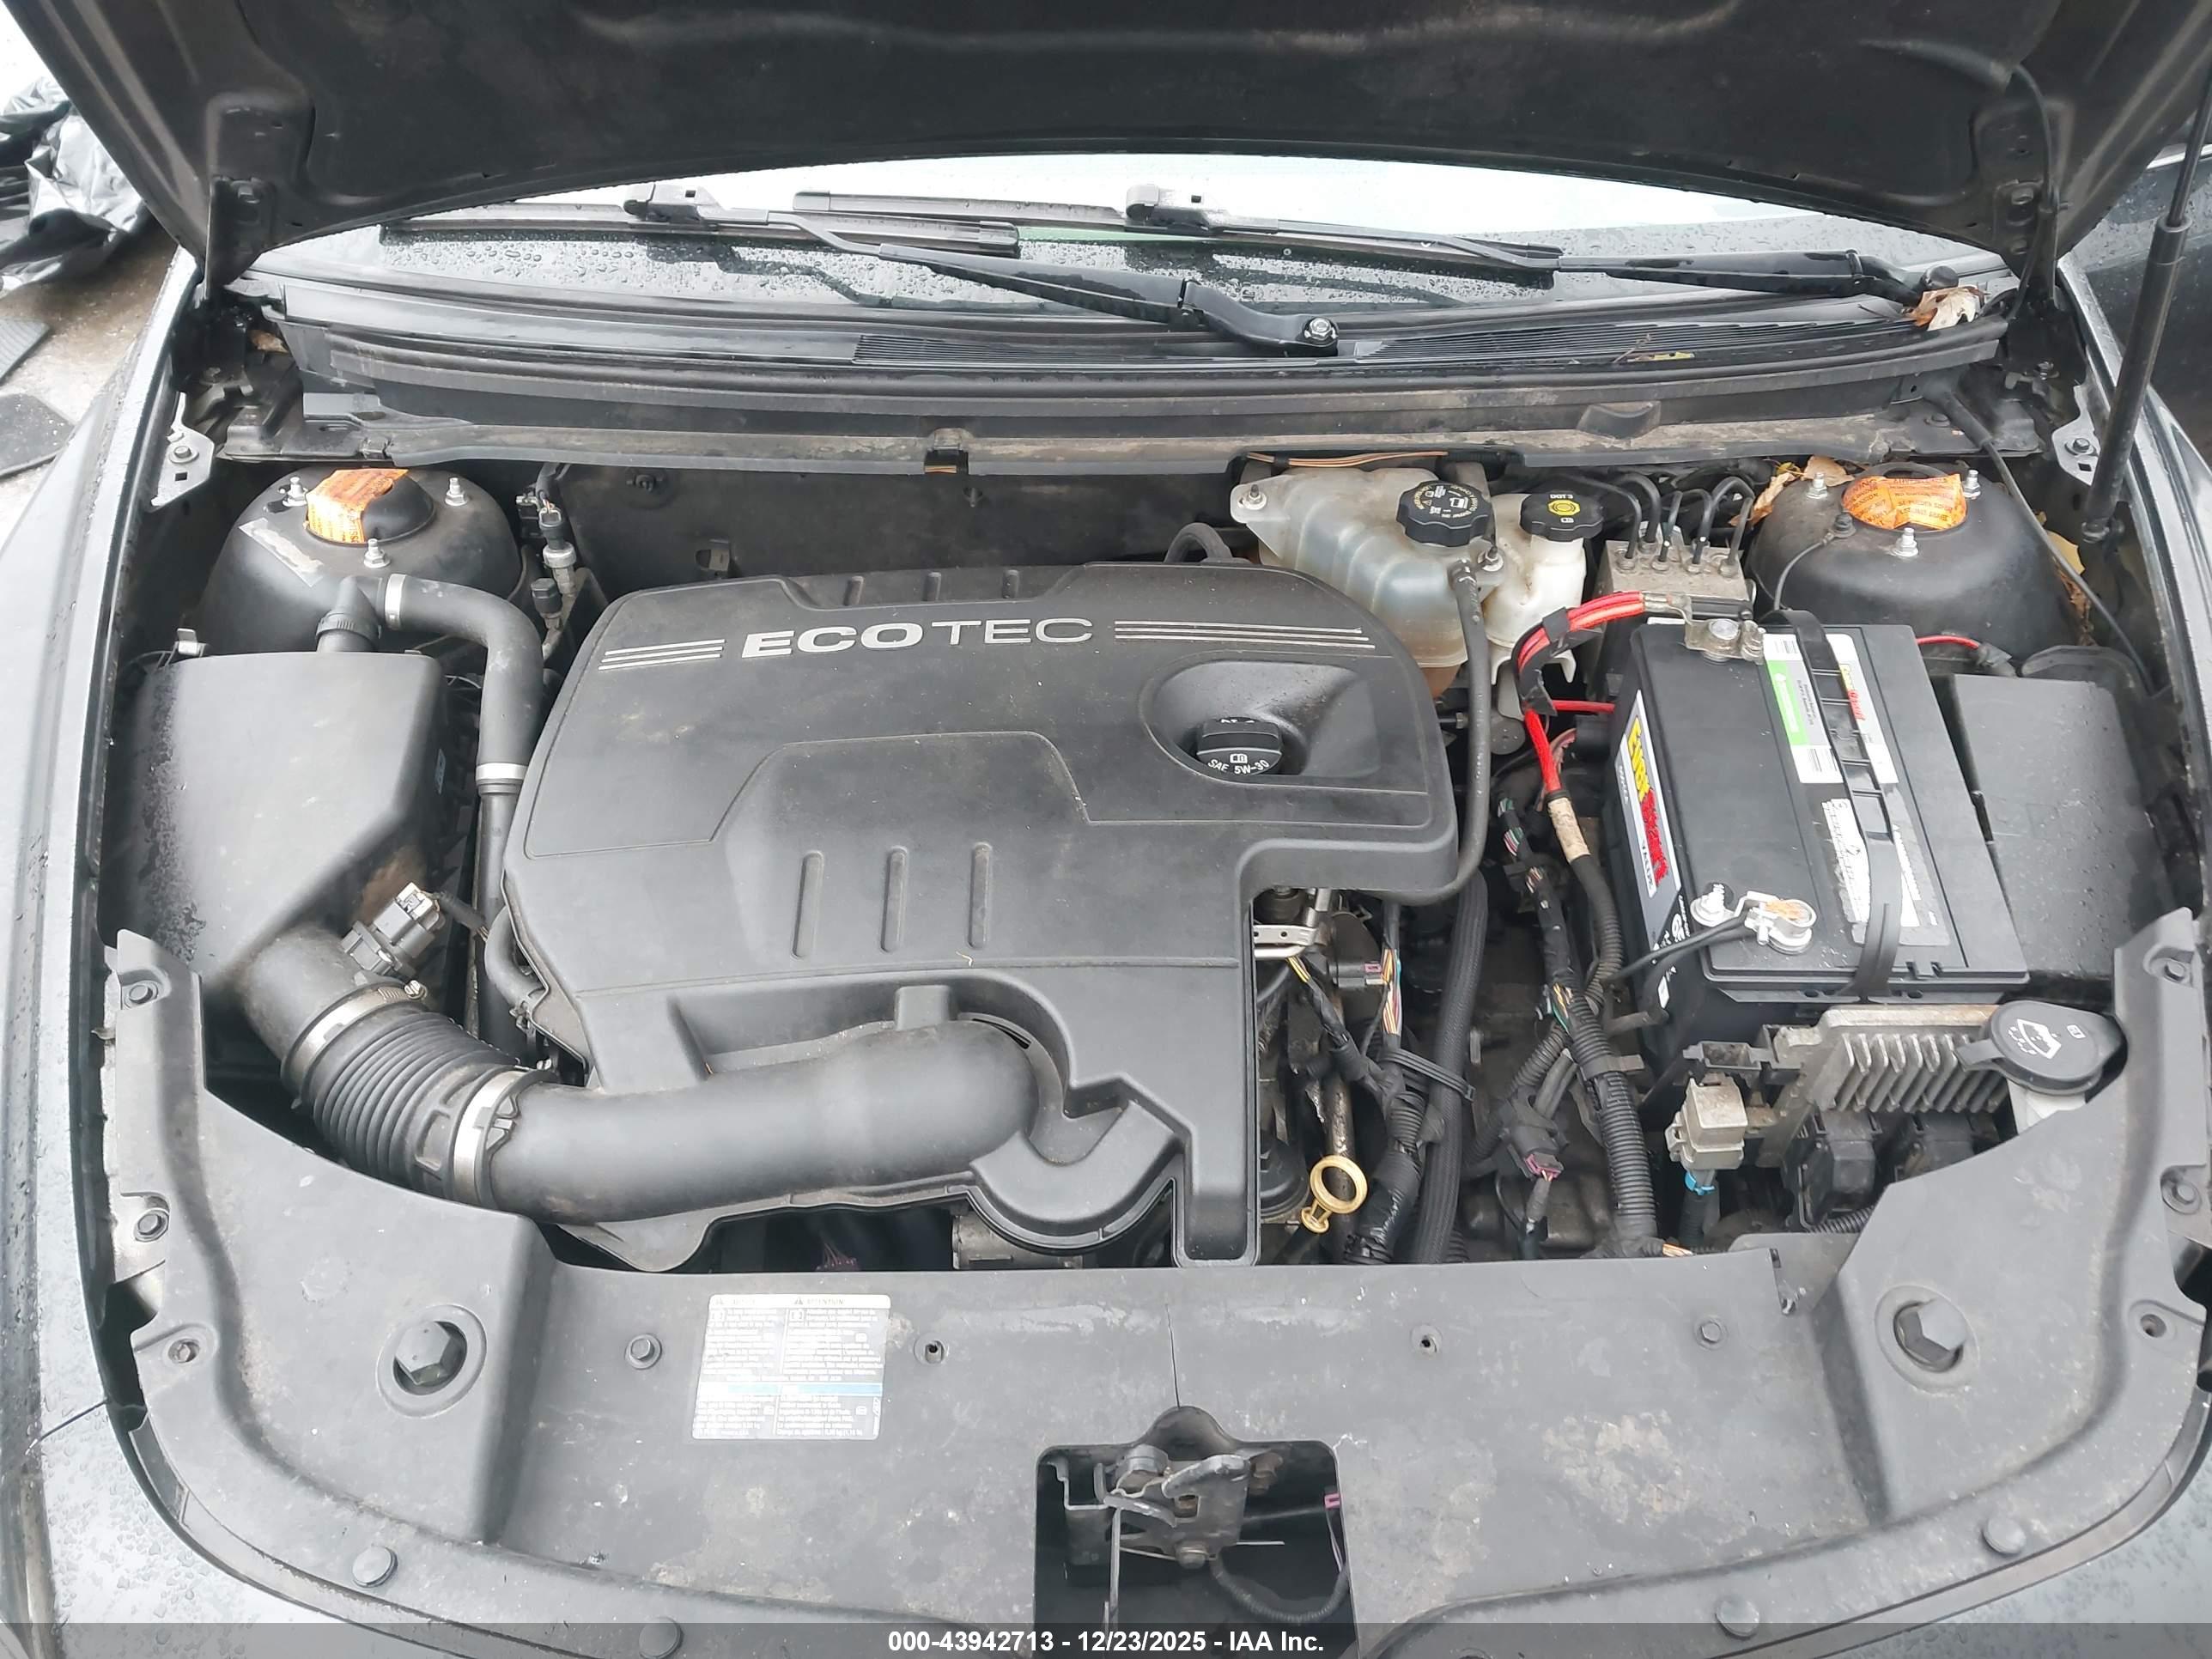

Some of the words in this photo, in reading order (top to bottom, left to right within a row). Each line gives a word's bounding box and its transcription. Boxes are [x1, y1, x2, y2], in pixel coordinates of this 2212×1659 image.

[741, 617, 1093, 659] ECOTEC
[1207, 758, 1230, 772] SAE
[1234, 759, 1270, 775] 5W-30
